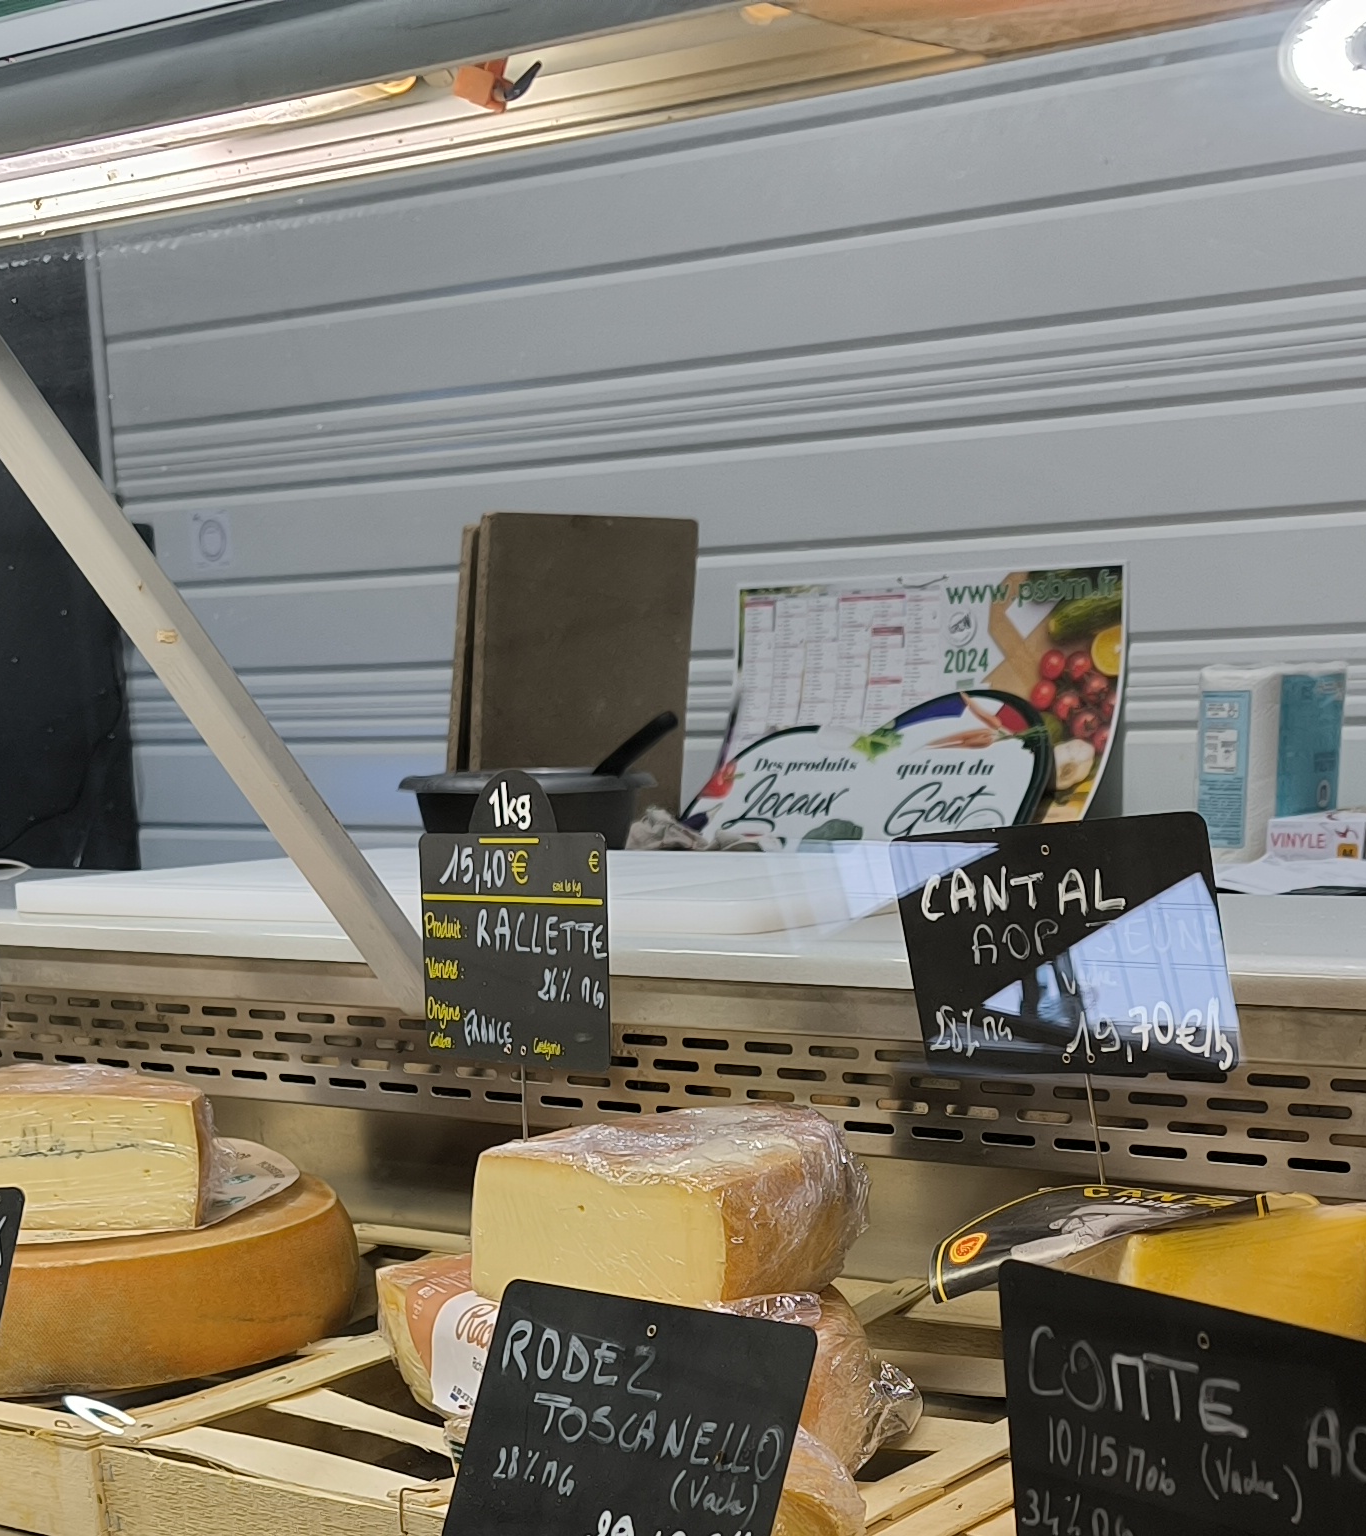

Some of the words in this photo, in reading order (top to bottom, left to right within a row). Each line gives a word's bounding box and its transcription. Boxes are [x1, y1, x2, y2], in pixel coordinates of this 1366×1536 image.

[946, 569, 1119, 606] www.psbm.fr
[943, 648, 989, 674] 2024
[753, 757, 783, 774] Des
[783, 757, 859, 777] produits
[897, 762, 930, 780] qui
[931, 762, 966, 776] ont
[968, 757, 996, 776] du
[488, 781, 533, 831] 1kg
[727, 773, 851, 831] Locaux
[1270, 832, 1326, 849] VINYLE
[920, 865, 1127, 922] CANTAL
[971, 918, 1060, 965] AOP
[464, 1008, 513, 1047] FRANCE
[501, 1318, 663, 1401] RODEZ
[533, 1392, 785, 1483] TOSCANELLO
